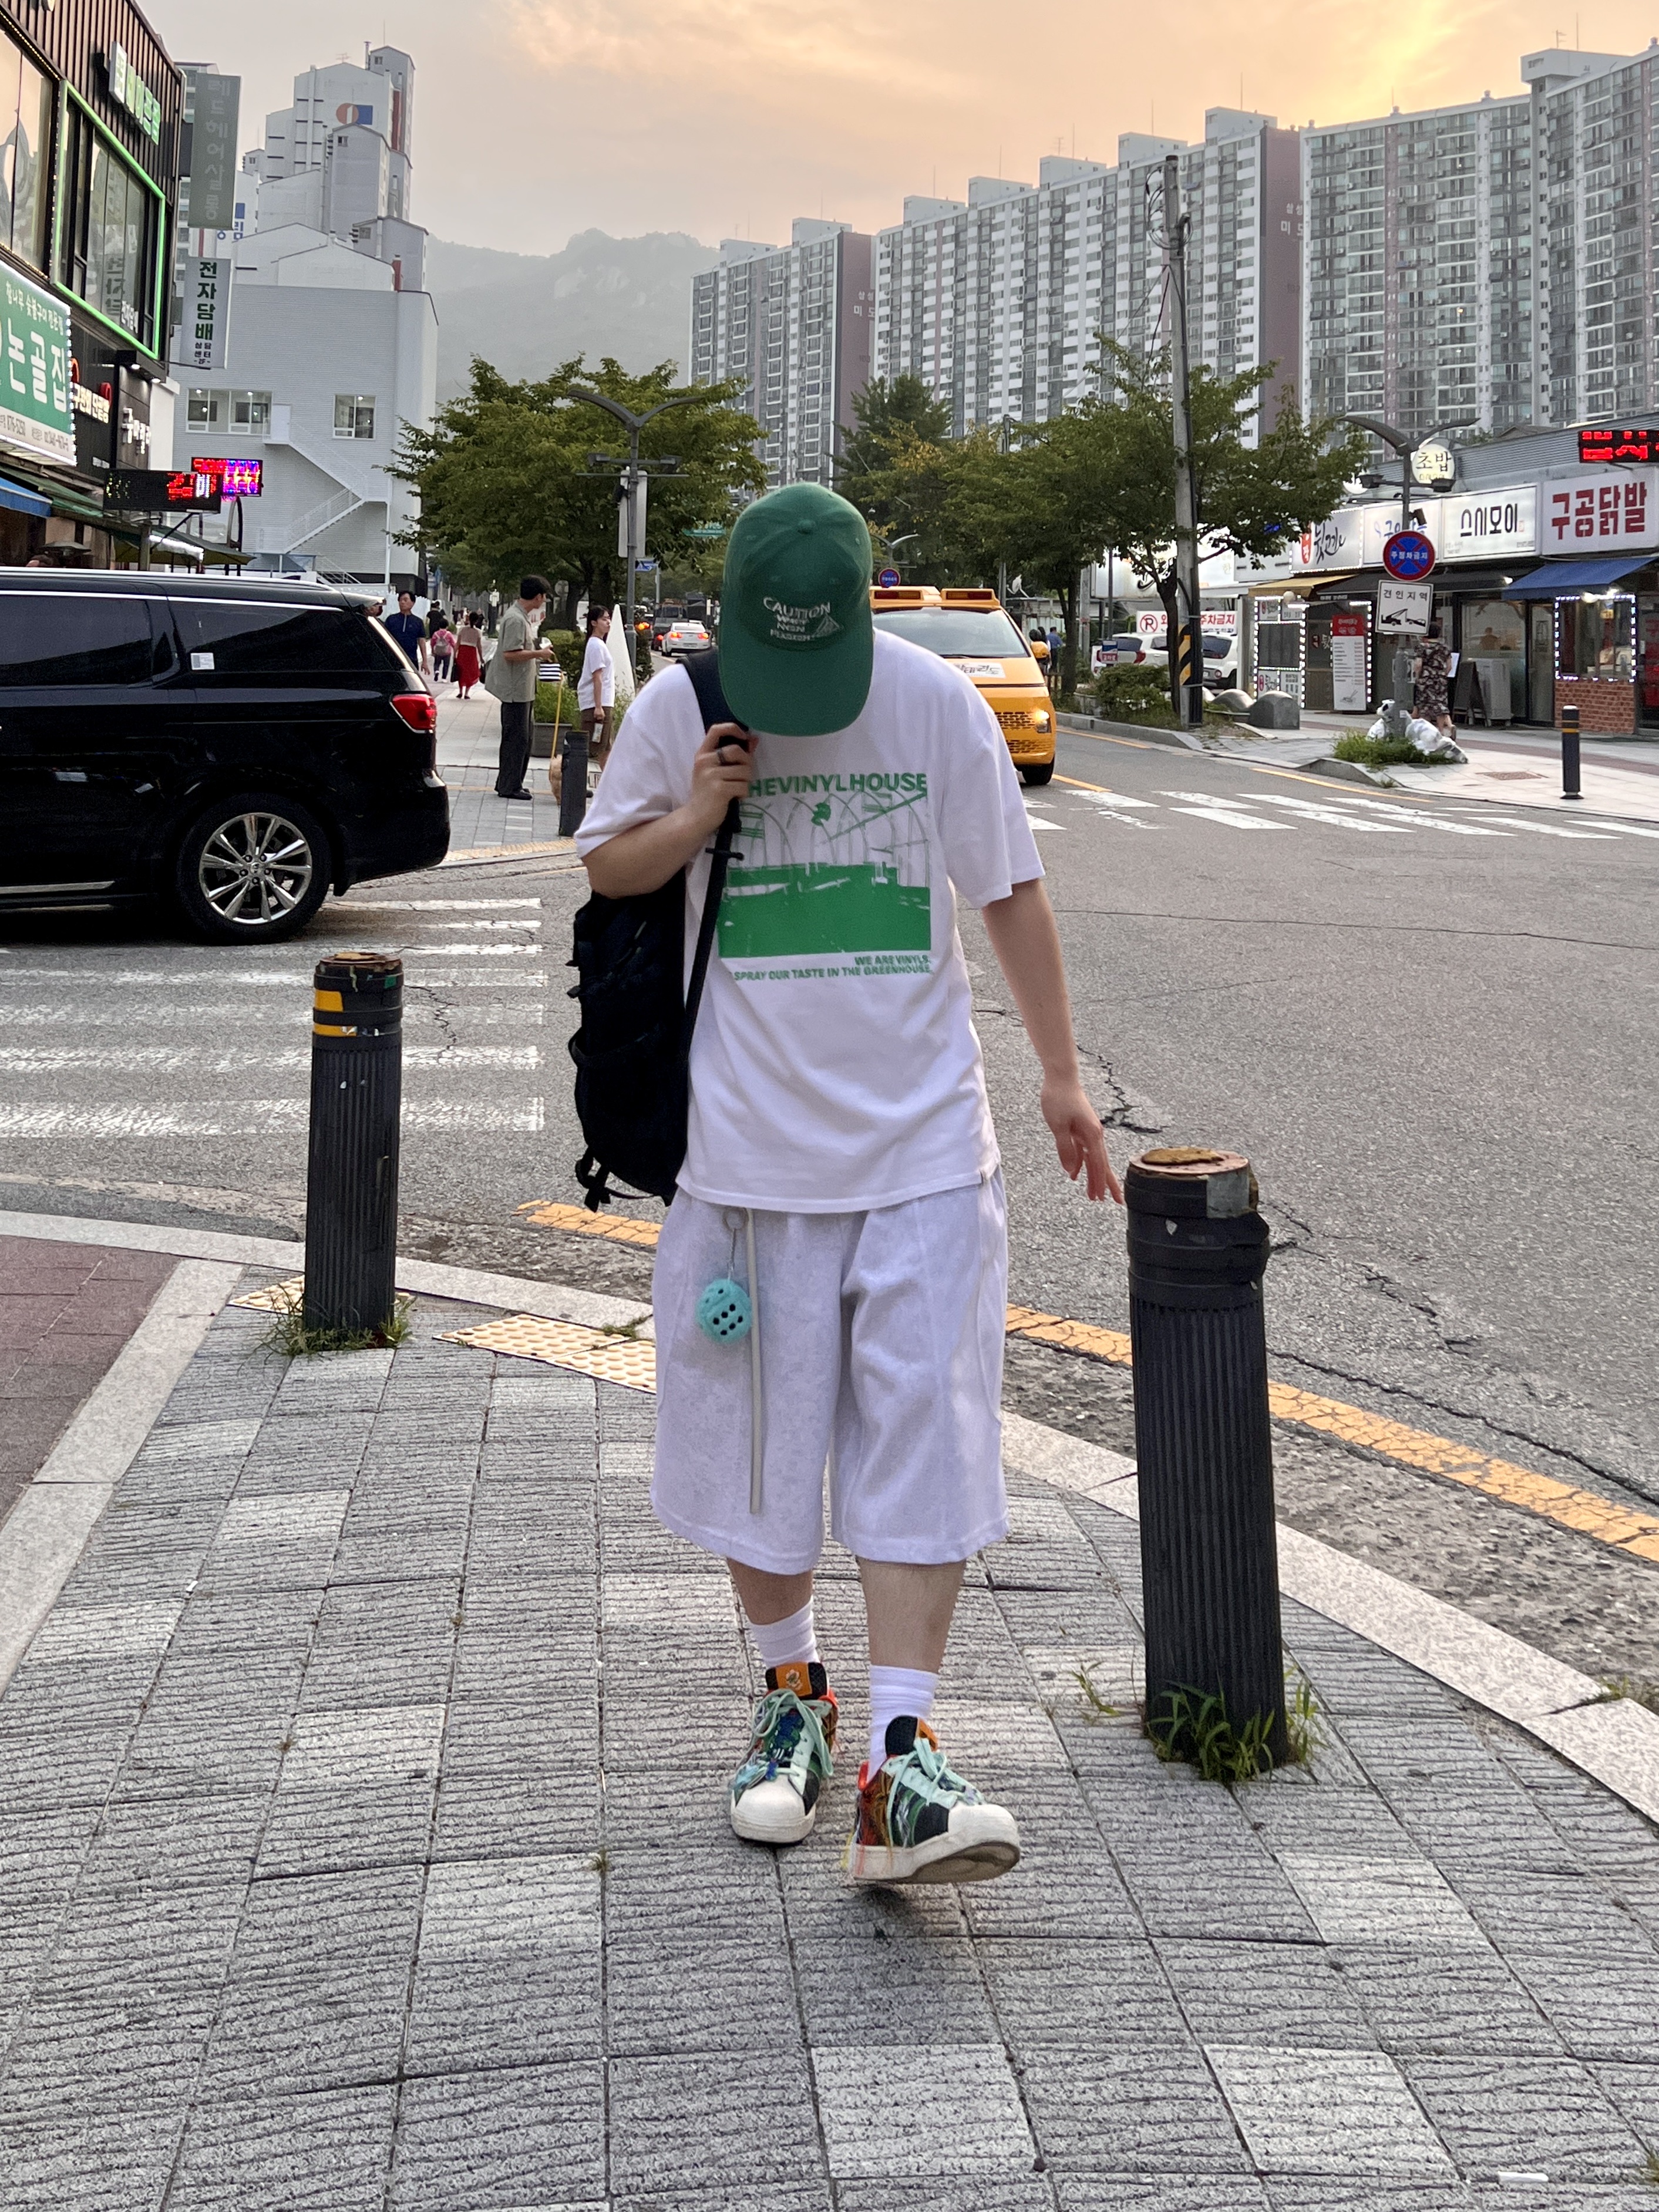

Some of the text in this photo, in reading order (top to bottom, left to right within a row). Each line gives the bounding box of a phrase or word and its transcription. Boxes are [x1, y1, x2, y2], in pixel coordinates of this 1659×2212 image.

[195, 261, 217, 341] 전자담배
[8, 317, 67, 413] 논골집
[1415, 450, 1452, 472] 초밥
[1461, 503, 1517, 537] 스시모이
[1552, 481, 1647, 540] 구공닭발
[1391, 551, 1428, 560] 주정차금지
[1383, 589, 1428, 601] 견인지역
[763, 597, 830, 618] CAUTION
[1200, 614, 1235, 625] 주차금지
[748, 772, 927, 797] HEVINYLHOUSE
[854, 956, 873, 966] WE
[874, 955, 894, 965] ARE
[734, 971, 767, 981] SPRAY
[768, 970, 790, 980] OUR
[790, 968, 825, 979] TASTE
[827, 968, 840, 978] IN
[840, 967, 860, 977] THE
